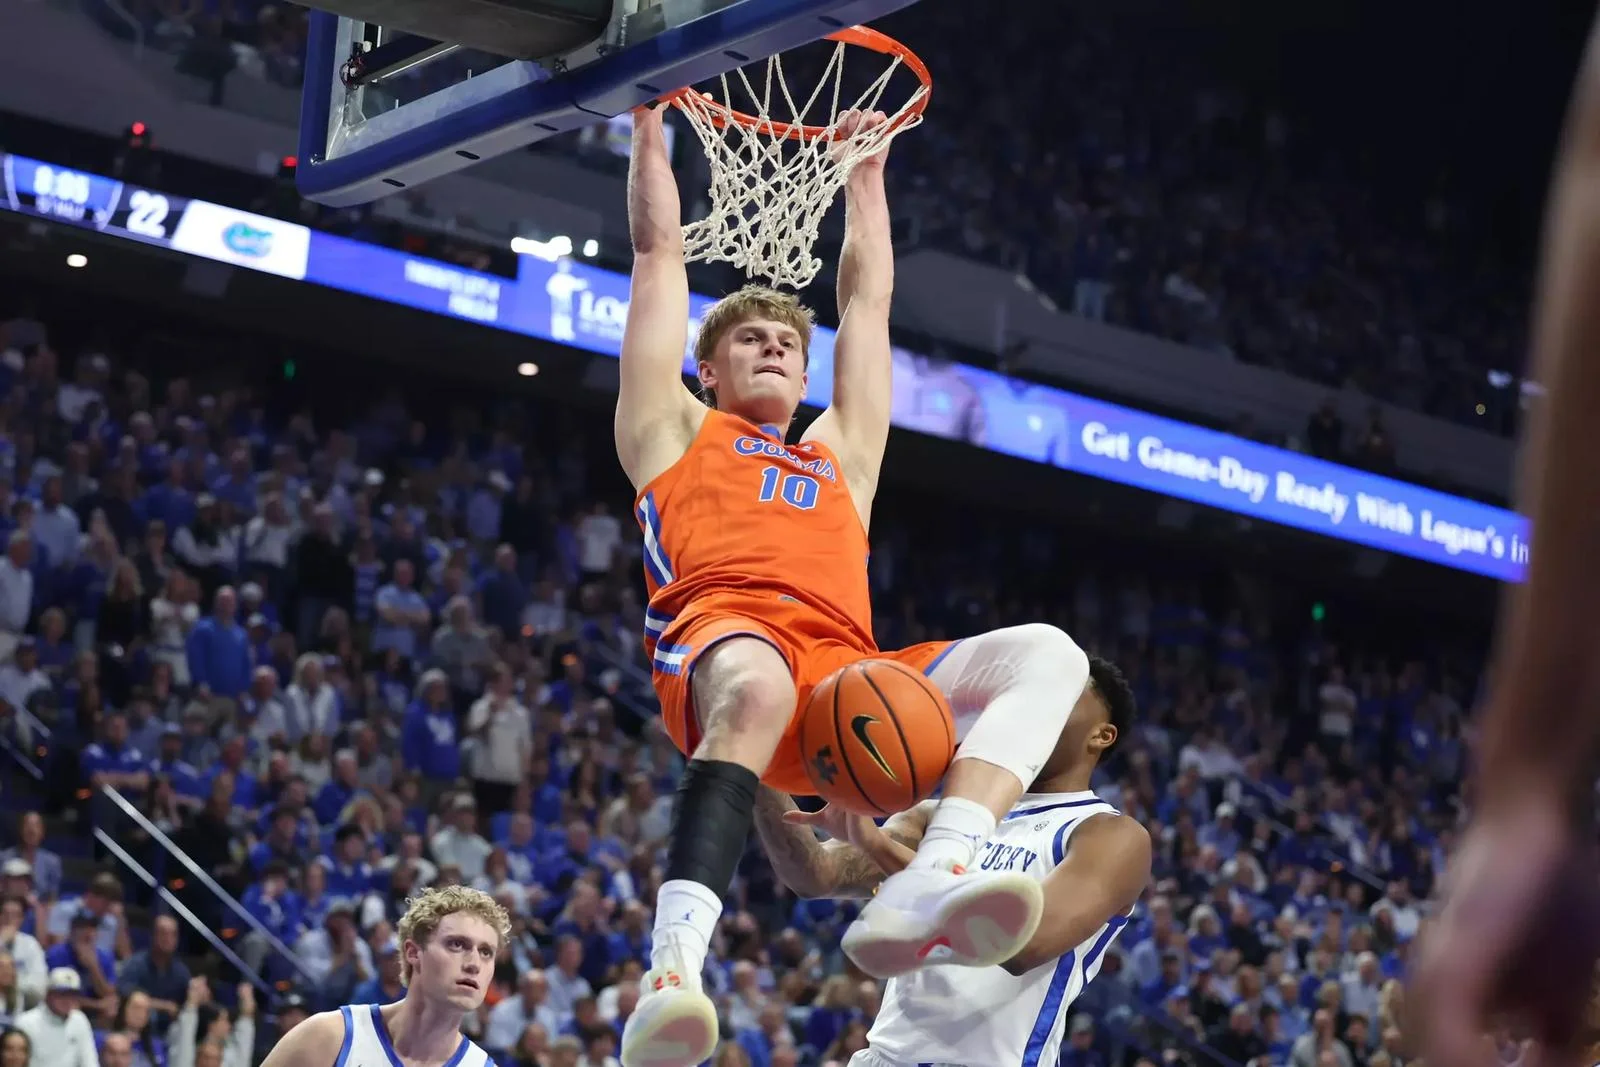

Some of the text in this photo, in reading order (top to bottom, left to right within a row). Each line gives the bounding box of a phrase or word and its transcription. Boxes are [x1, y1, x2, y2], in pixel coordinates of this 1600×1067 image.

[126, 190, 170, 239] 22
[758, 465, 821, 511] 10
[1081, 421, 1131, 462] Get
[1137, 435, 1270, 504] Game-Day
[1275, 470, 1350, 525] Ready
[1356, 491, 1414, 536] With
[1420, 509, 1505, 559] Logan's
[980, 840, 1038, 873] UCKY
